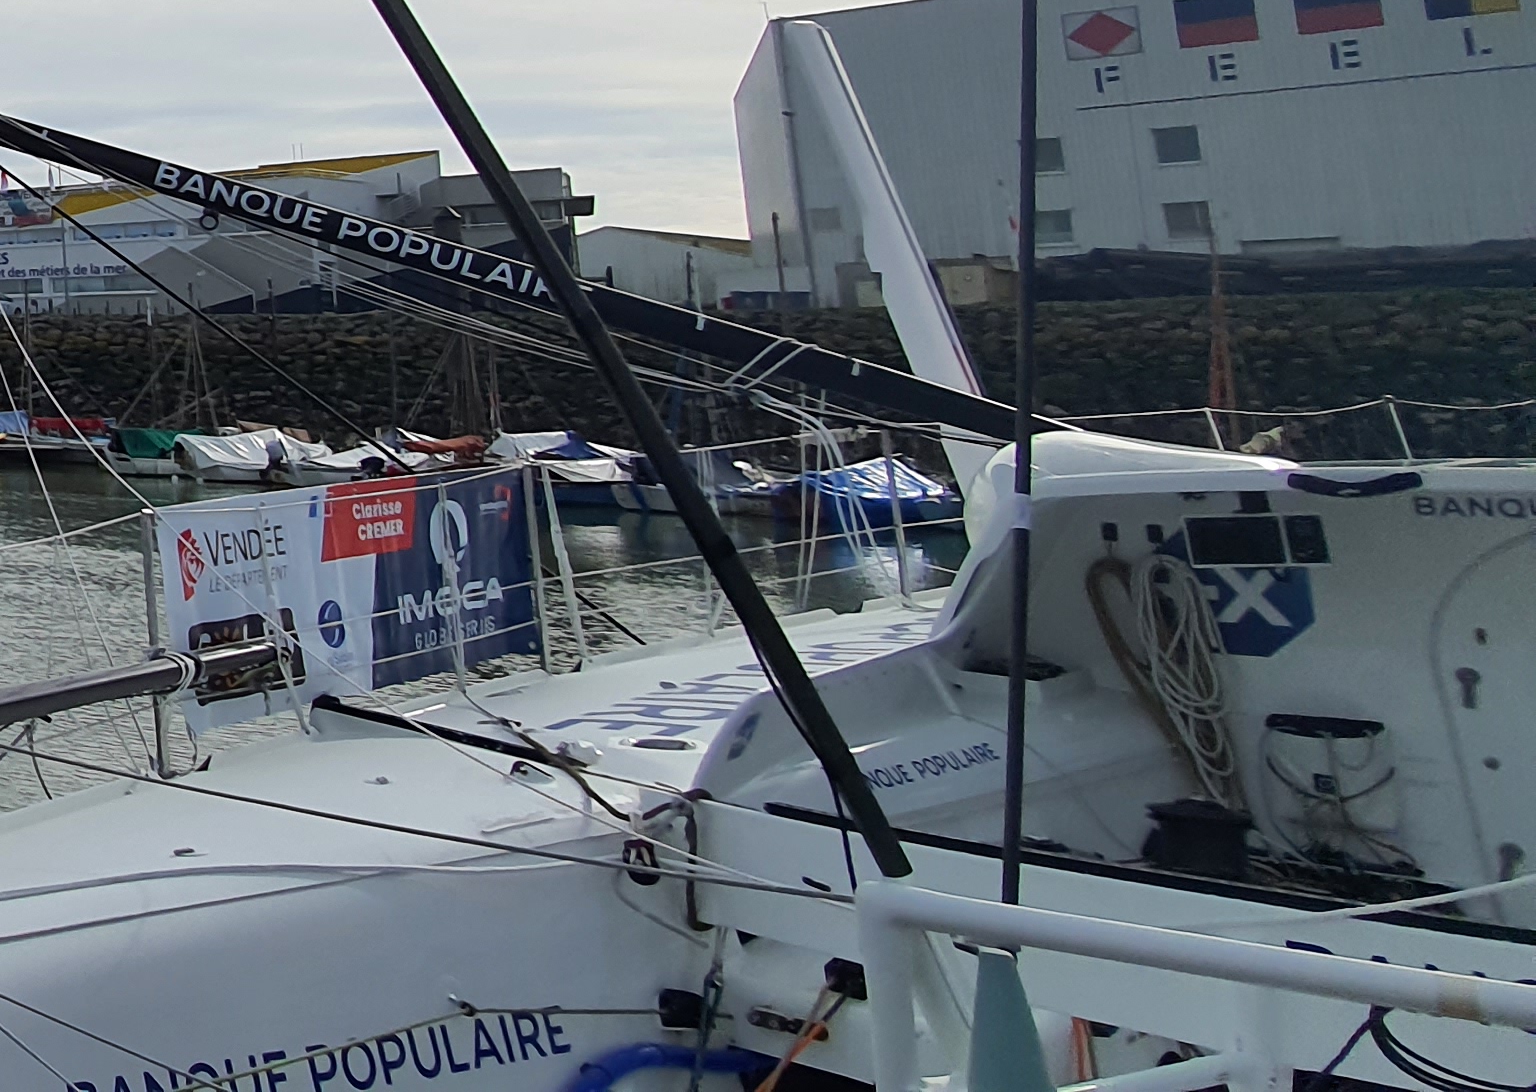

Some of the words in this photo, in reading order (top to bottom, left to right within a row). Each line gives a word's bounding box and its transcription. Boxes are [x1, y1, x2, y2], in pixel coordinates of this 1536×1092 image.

[153, 161, 328, 234] BANQUE
[7, 266, 26, 278] des
[28, 265, 69, 277] métiers
[72, 263, 87, 275] de
[90, 263, 100, 275] la
[352, 499, 403, 519] Clarisse
[357, 518, 404, 542] CREMER
[202, 518, 287, 567] VENDÉE
[397, 576, 504, 625] IMOCA
[910, 742, 1001, 780] POPULAIRE
[308, 1005, 573, 1092] POPULAIRE
